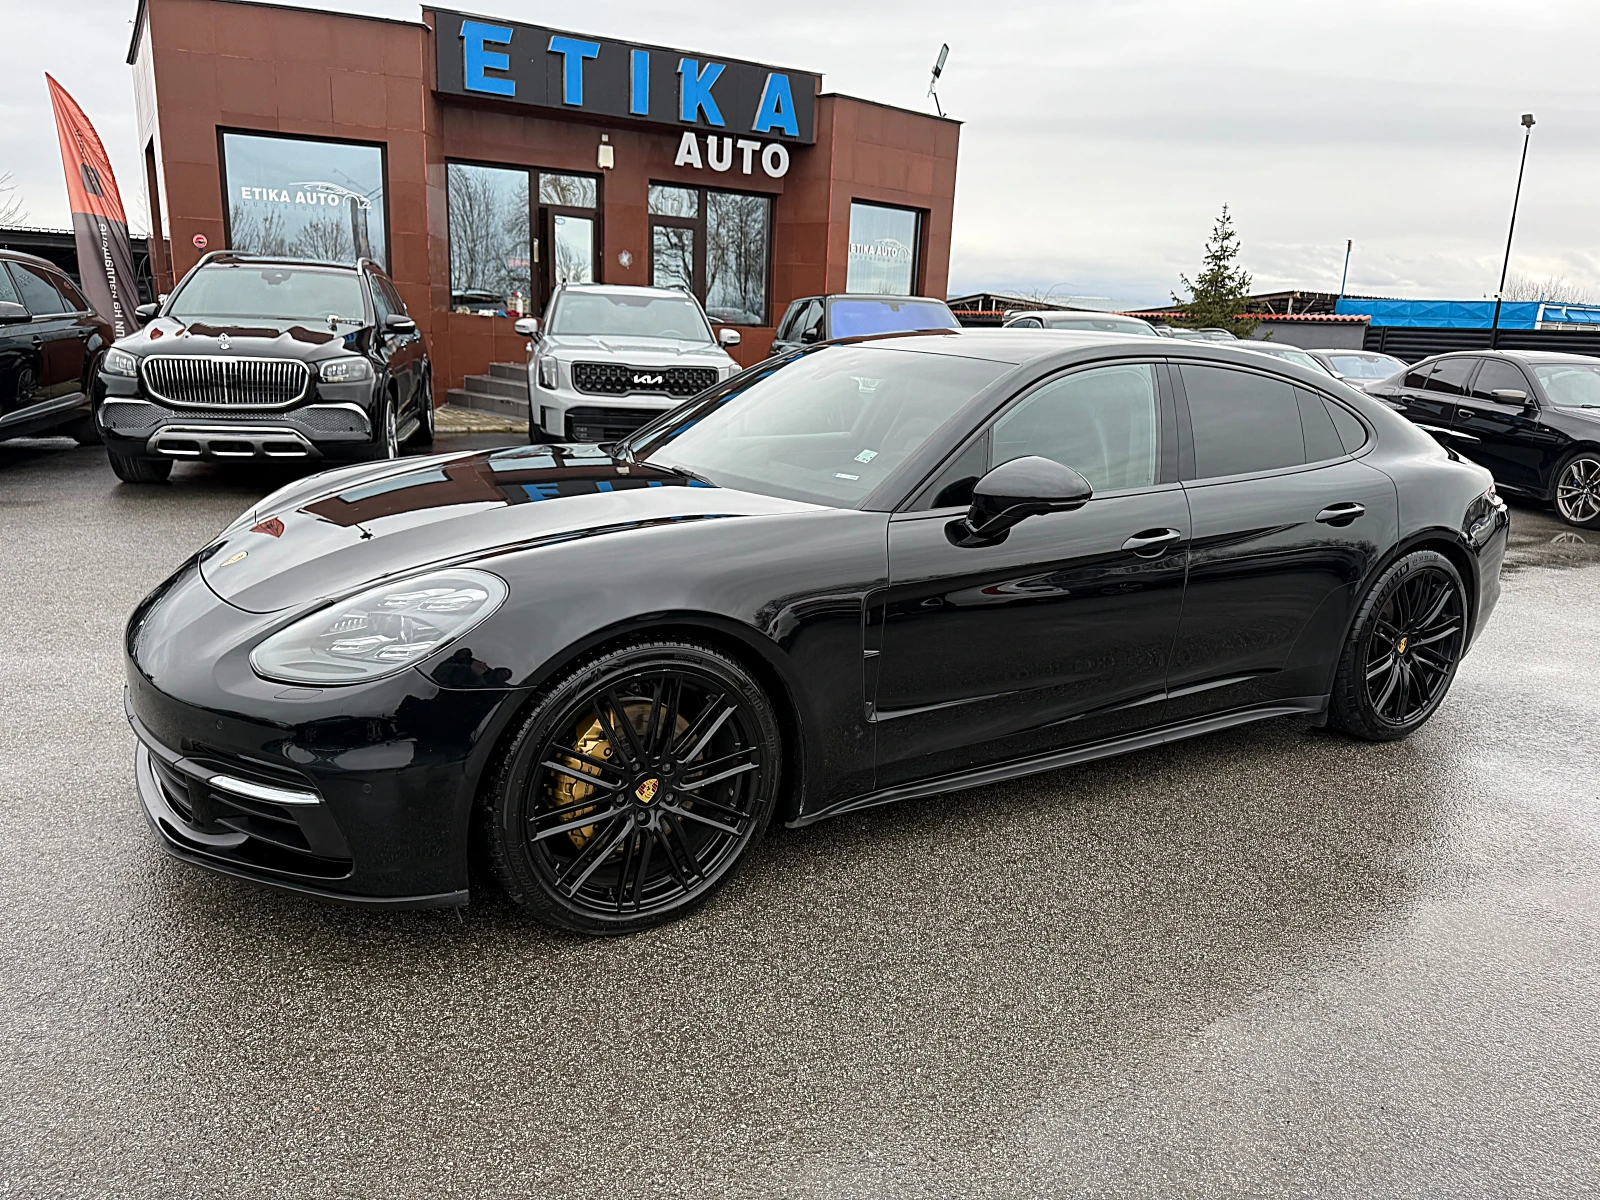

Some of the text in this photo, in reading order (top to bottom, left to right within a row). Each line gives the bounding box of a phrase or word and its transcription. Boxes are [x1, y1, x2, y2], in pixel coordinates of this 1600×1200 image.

[459, 20, 800, 137] ETIKA
[674, 131, 790, 178] AUTO
[241, 187, 339, 206] ETIKA AUTO
[850, 243, 897, 257] ETIKA AUTO
[633, 375, 662, 384] KIA
